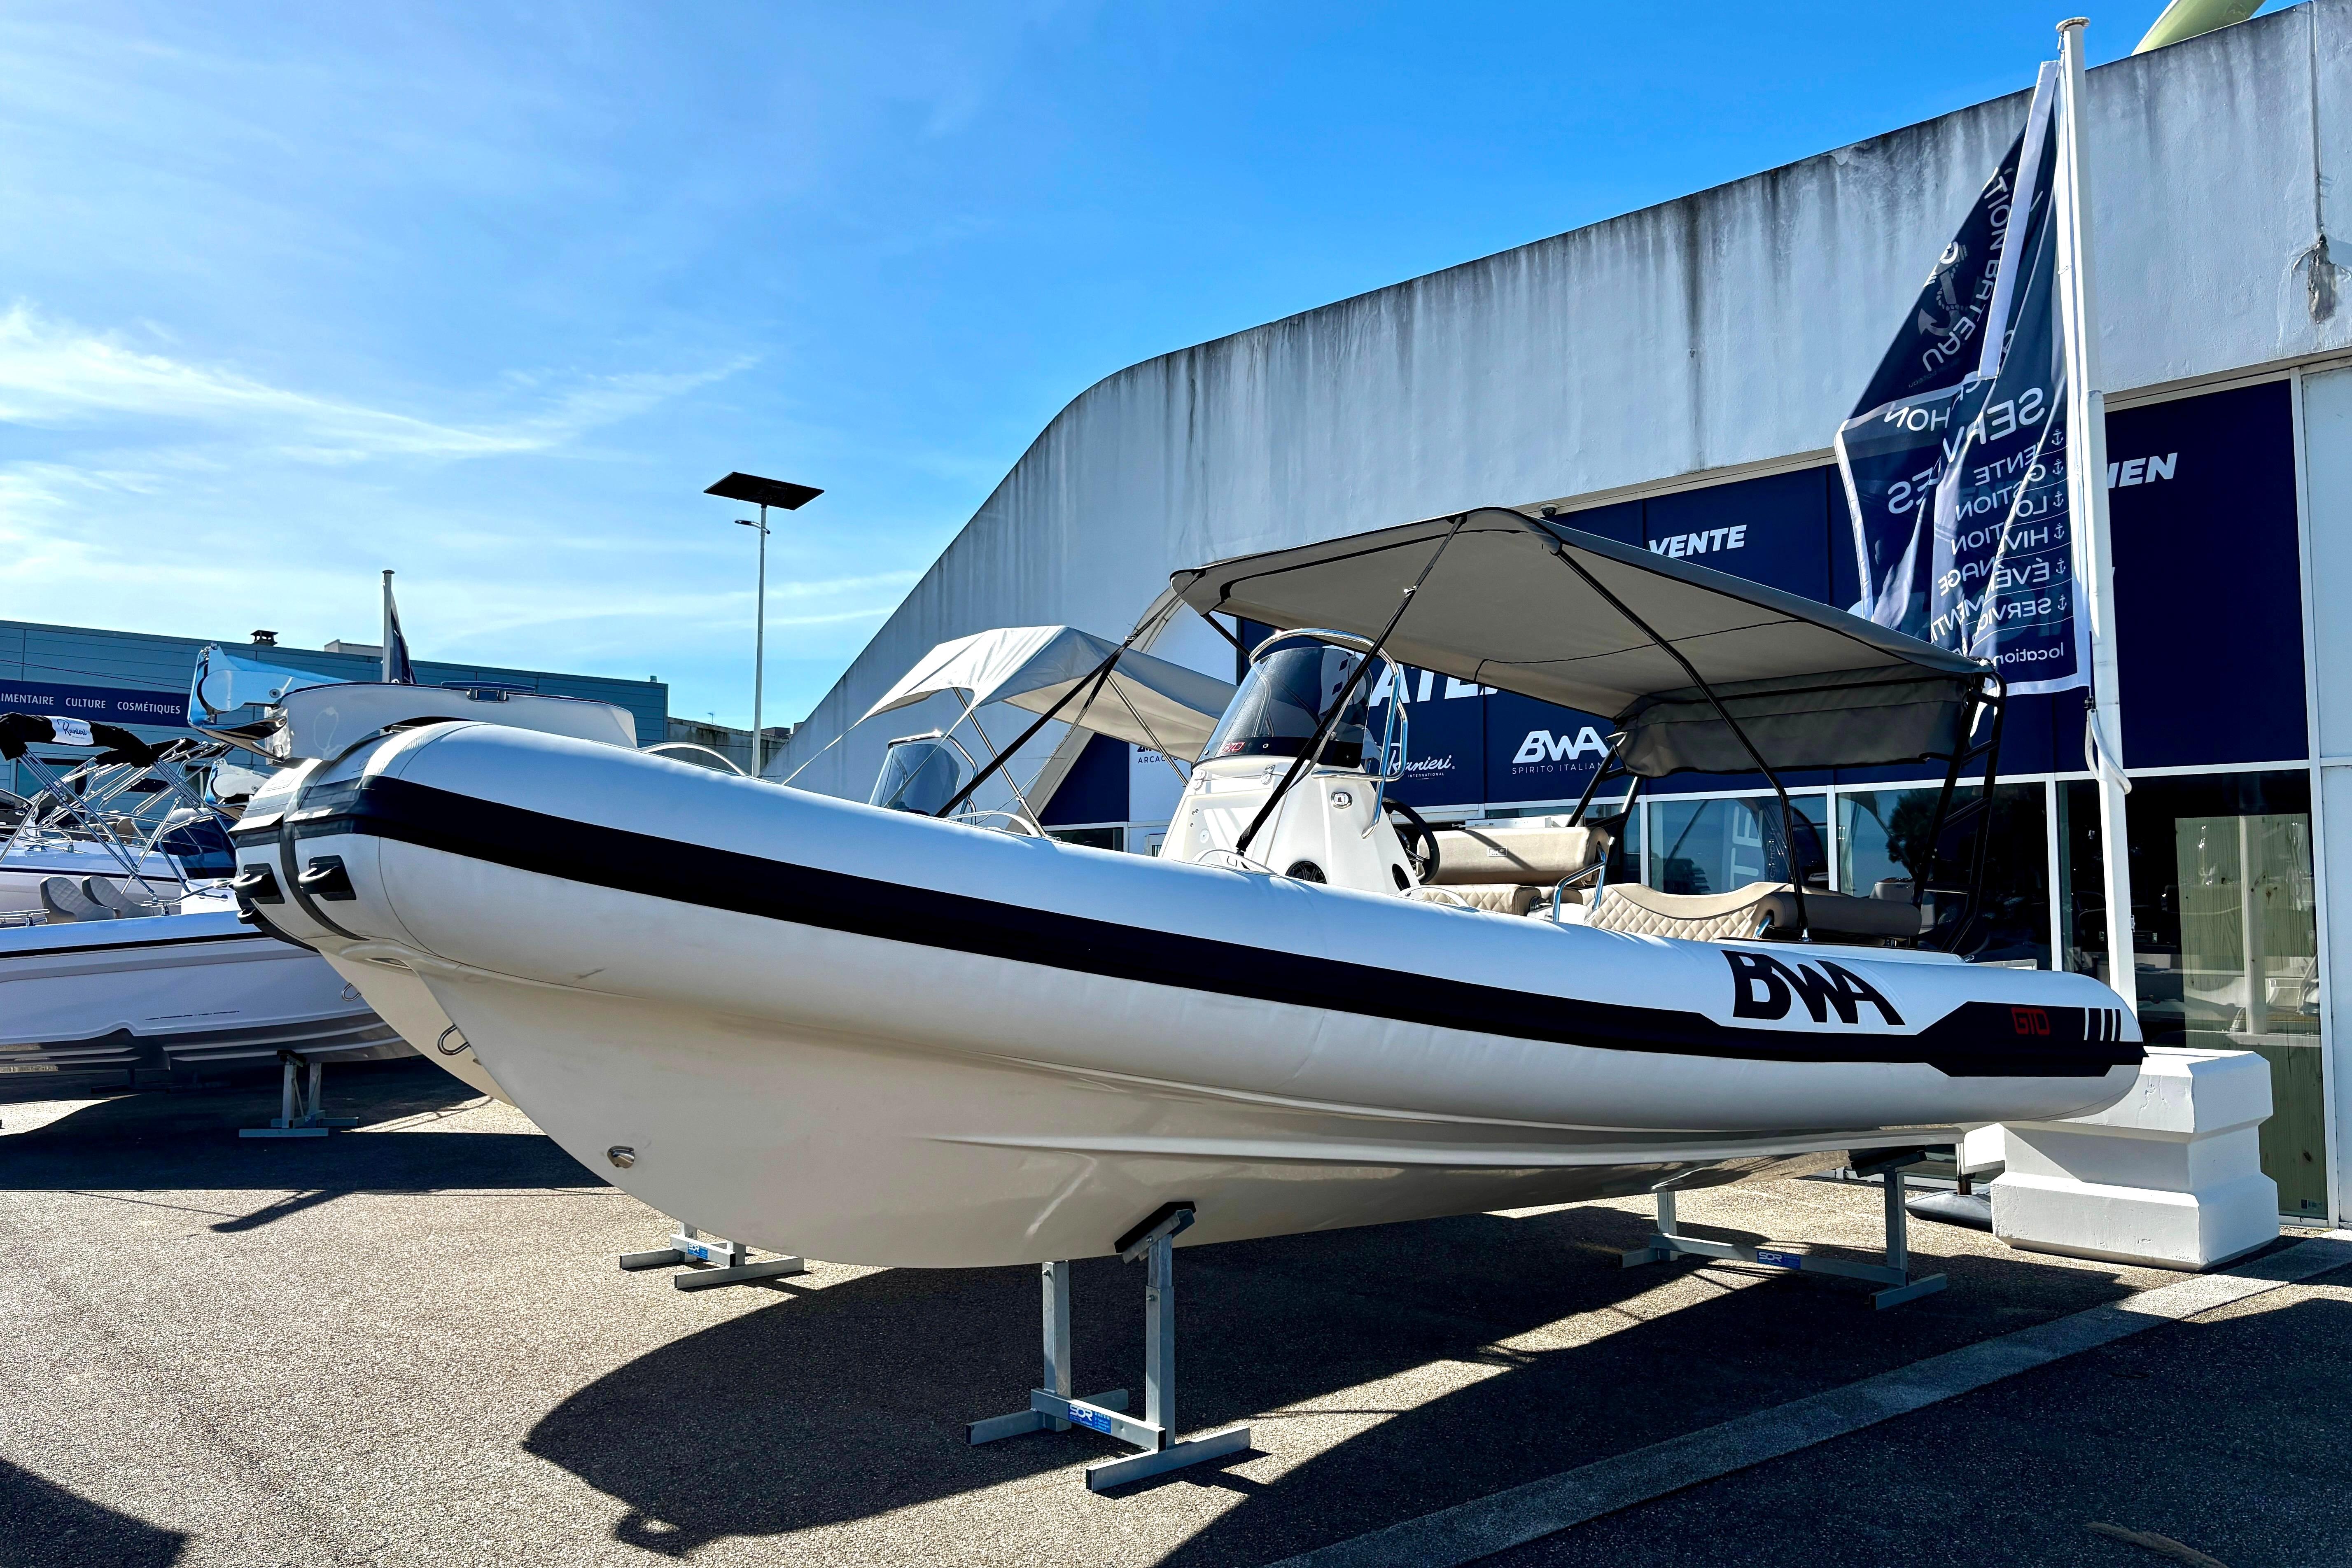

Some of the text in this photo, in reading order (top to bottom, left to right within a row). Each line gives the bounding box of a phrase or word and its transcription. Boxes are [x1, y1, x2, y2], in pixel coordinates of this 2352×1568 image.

[1648, 524, 1747, 558] VENTE
[65, 698, 106, 709] CULTURE
[117, 701, 181, 715] COSMÉTIQUES
[56, 719, 87, 736] Ranieri
[1512, 726, 1609, 764] BWA
[1512, 762, 1612, 775] SPIRITO ITALIAN
[1720, 950, 1906, 1026] BWA
[1758, 1251, 1783, 1262] SOR
[1069, 1404, 1093, 1421] SOR
